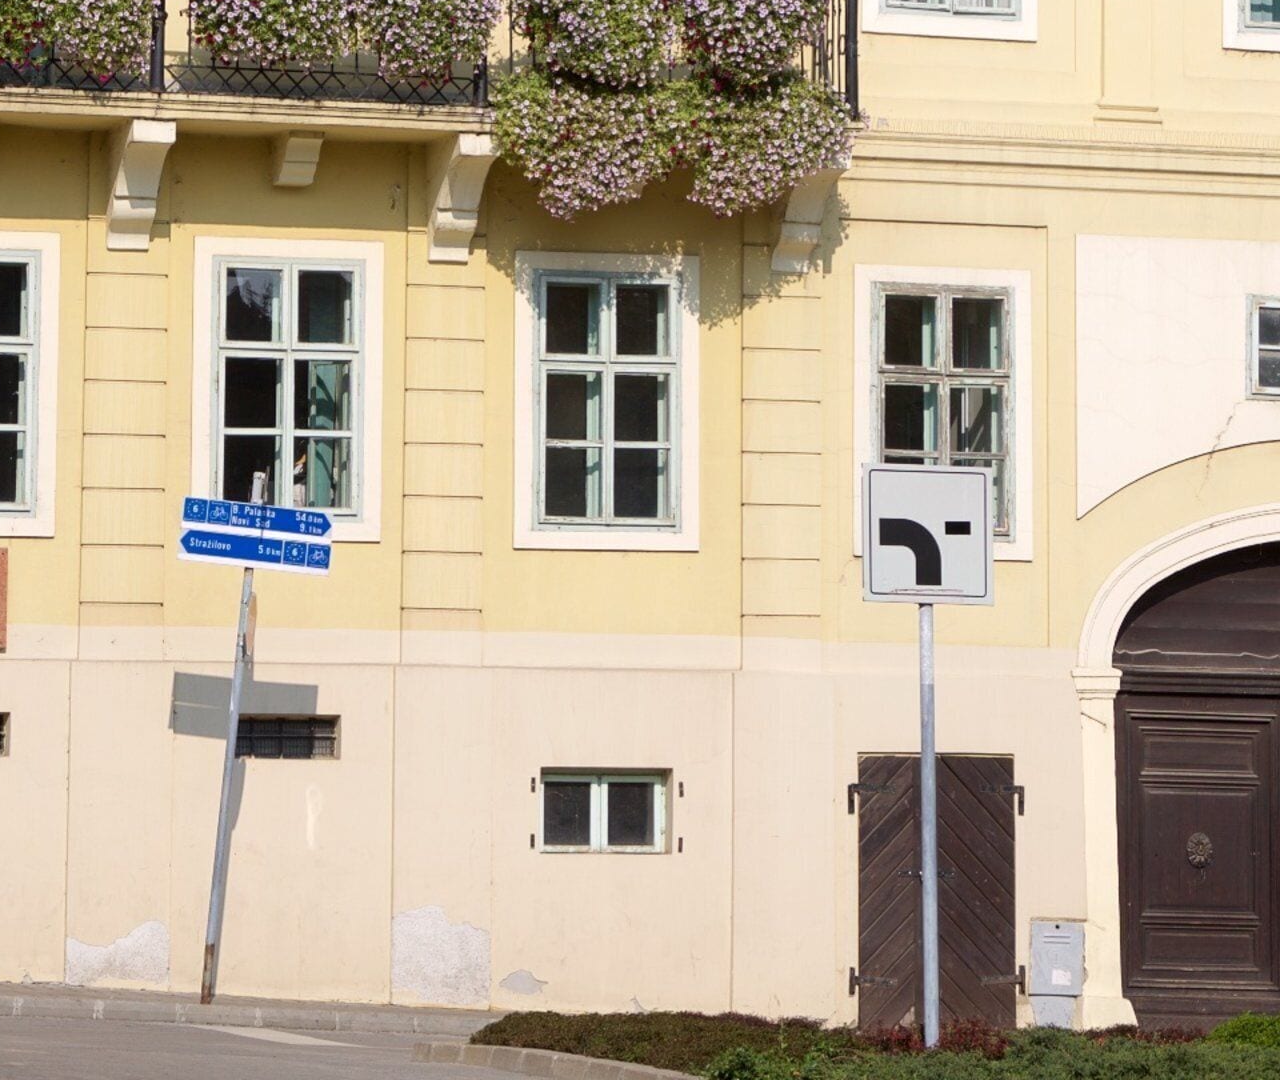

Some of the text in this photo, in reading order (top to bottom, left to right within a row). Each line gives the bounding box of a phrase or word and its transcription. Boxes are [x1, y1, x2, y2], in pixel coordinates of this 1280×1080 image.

[192, 504, 199, 513] 6
[231, 515, 250, 526] Novi
[190, 537, 232, 551] Stražilovo
